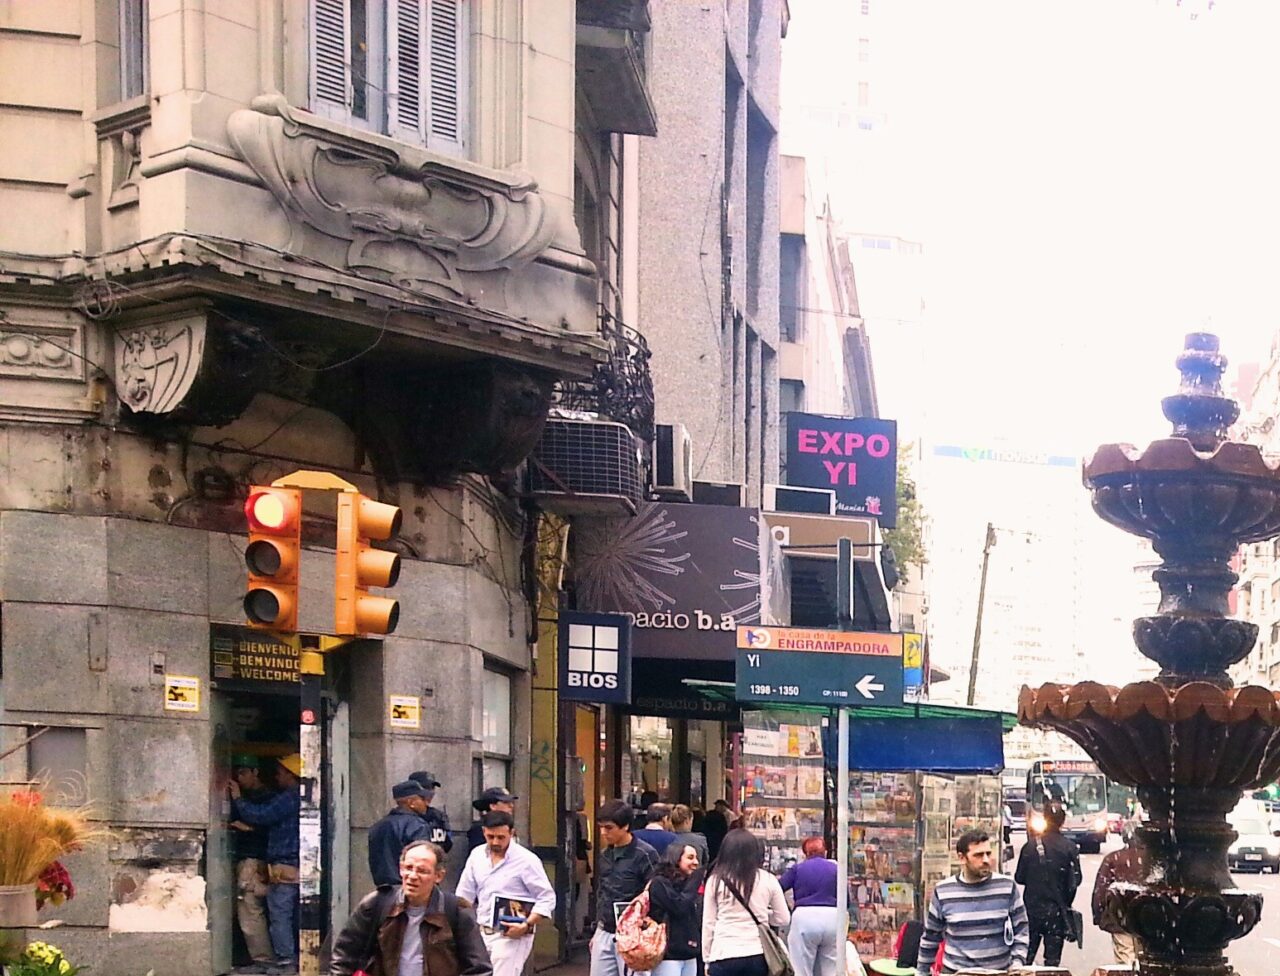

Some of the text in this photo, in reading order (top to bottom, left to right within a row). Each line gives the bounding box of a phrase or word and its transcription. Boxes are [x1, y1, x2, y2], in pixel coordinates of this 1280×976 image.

[798, 429, 890, 457] EXPO
[822, 460, 857, 485] YI
[778, 638, 889, 654] ENGRAMPADORA
[240, 668, 300, 682] WELCOME
[568, 672, 618, 689] BIOS
[750, 684, 771, 695] 1398
[778, 685, 799, 696] 1350
